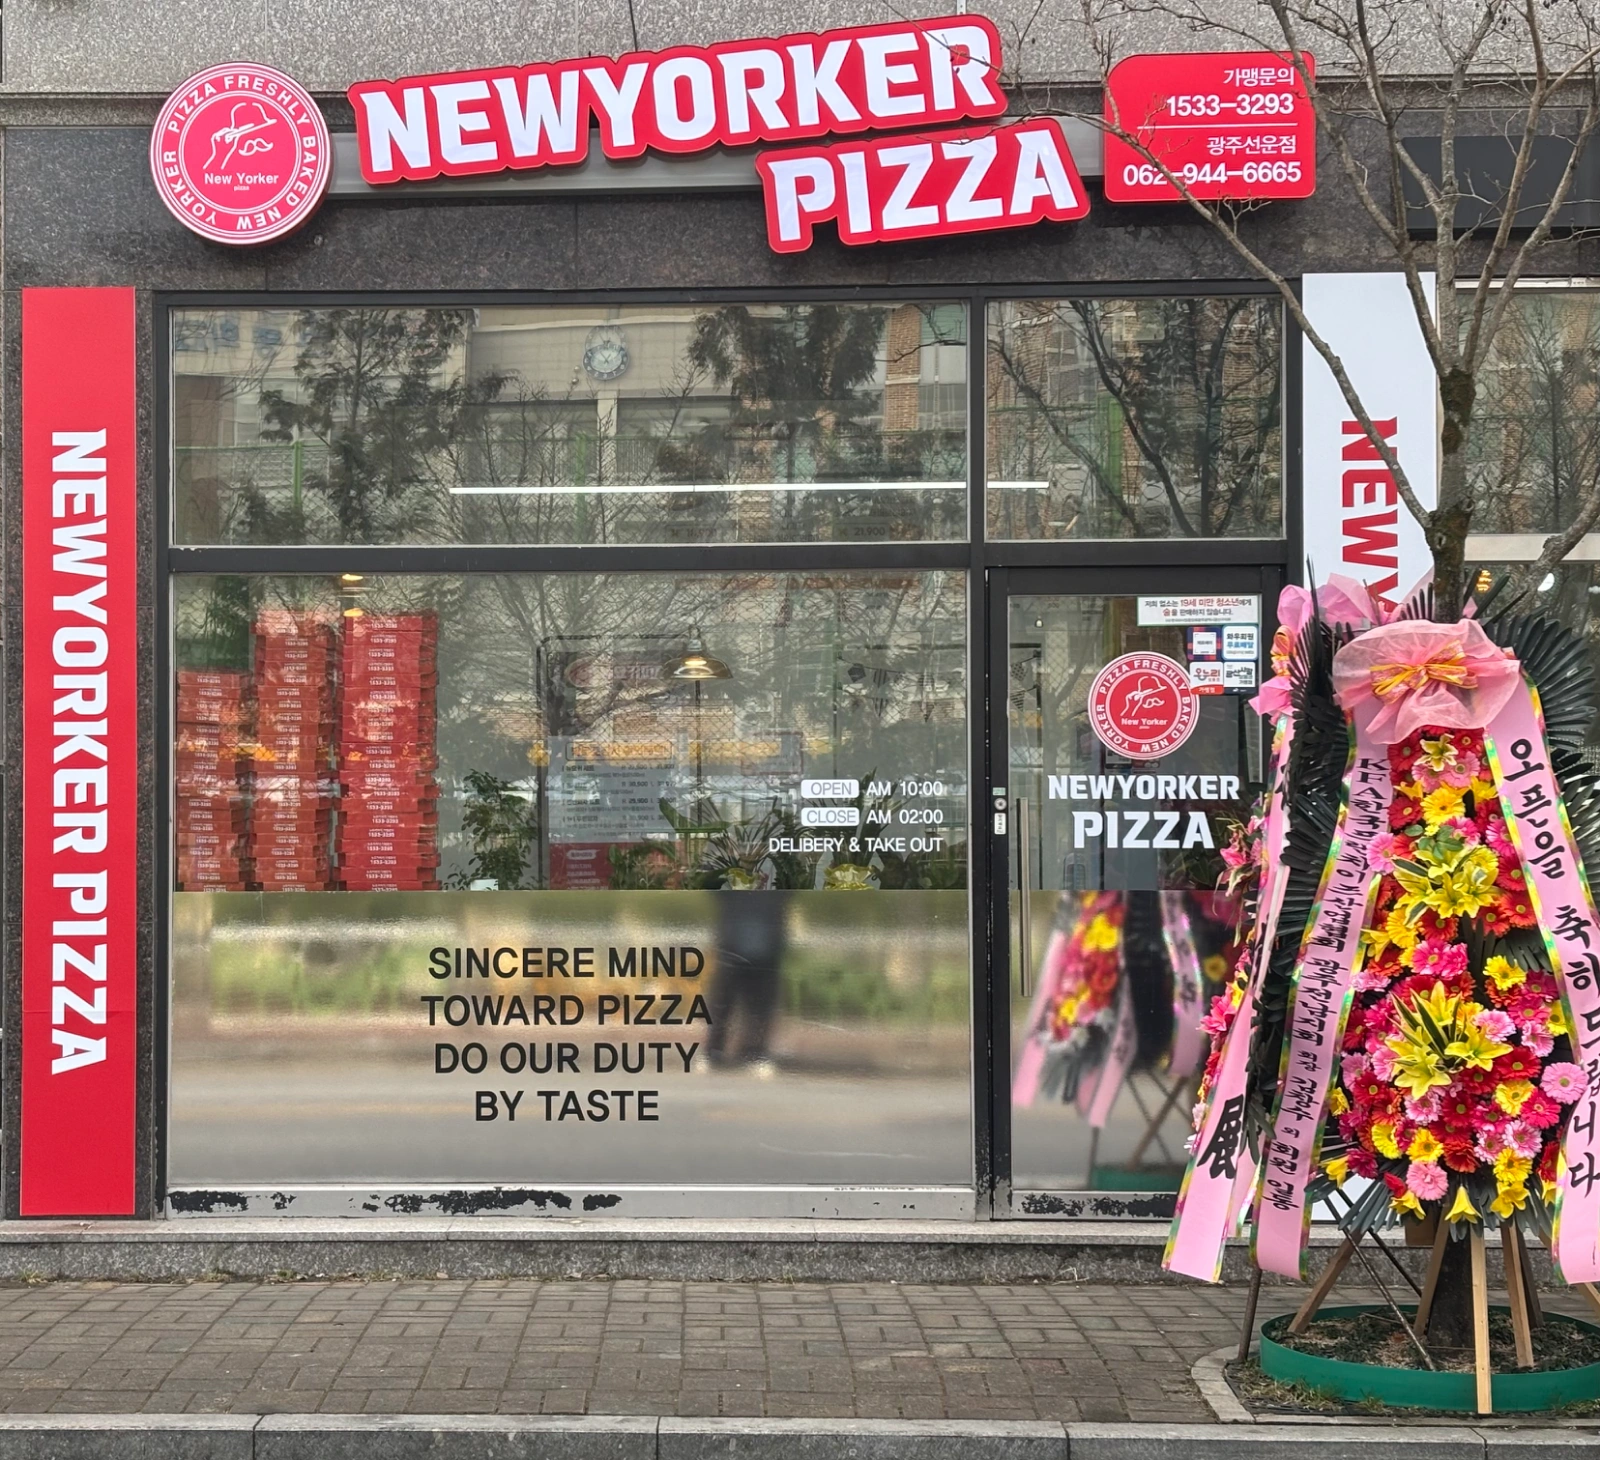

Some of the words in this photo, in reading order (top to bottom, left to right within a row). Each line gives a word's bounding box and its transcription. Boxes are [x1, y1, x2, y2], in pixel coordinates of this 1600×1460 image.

[1223, 67, 1295, 87] 가맹문의
[168, 82, 217, 133] PIZZA
[224, 75, 311, 125] FRESHLY
[359, 24, 997, 173] NEWYORKER
[1166, 93, 1294, 117] 1533-3293
[1206, 135, 1297, 155] 광주선운점
[204, 173, 232, 185] New
[236, 173, 279, 185] Yorker
[286, 135, 317, 206] BAKED
[767, 129, 1079, 242] PIZZA
[1123, 161, 1302, 186] 062-944-6665
[164, 151, 216, 225] YORKER
[236, 208, 282, 230] NEW
[52, 428, 109, 853] NEWYORKER
[1099, 664, 1130, 694] PIZZA
[1134, 660, 1187, 690] FRESHLY
[1096, 704, 1129, 749] YORKER
[1121, 718, 1139, 726] New
[1141, 718, 1168, 726] Yorker
[1171, 697, 1191, 739] BAKED
[1140, 739, 1169, 752] NEW
[810, 781, 853, 796] OPEN
[866, 781, 892, 796] AM
[899, 781, 943, 796] 10:00
[1047, 774, 1240, 800] NEWYORKER
[806, 809, 857, 824] CLOSE
[866, 809, 892, 824] AM
[899, 809, 944, 824] 02:00
[1504, 738, 1566, 879] 오픈을
[769, 838, 844, 852] DELIBERY
[849, 838, 861, 852] &
[865, 838, 906, 852] TAKE
[910, 837, 944, 852] OUT
[1071, 811, 1215, 849] PIZZA
[52, 869, 109, 1076] PIZZA
[428, 947, 595, 979] SINCERE
[608, 947, 705, 978] MIND
[420, 995, 584, 1027] TOWARD
[598, 994, 713, 1025] PIZZA
[435, 1042, 488, 1074] DO
[500, 1042, 581, 1074] OUR
[594, 1042, 700, 1073] DUTY
[475, 1090, 524, 1122] BY
[537, 1090, 659, 1122] TASTE
